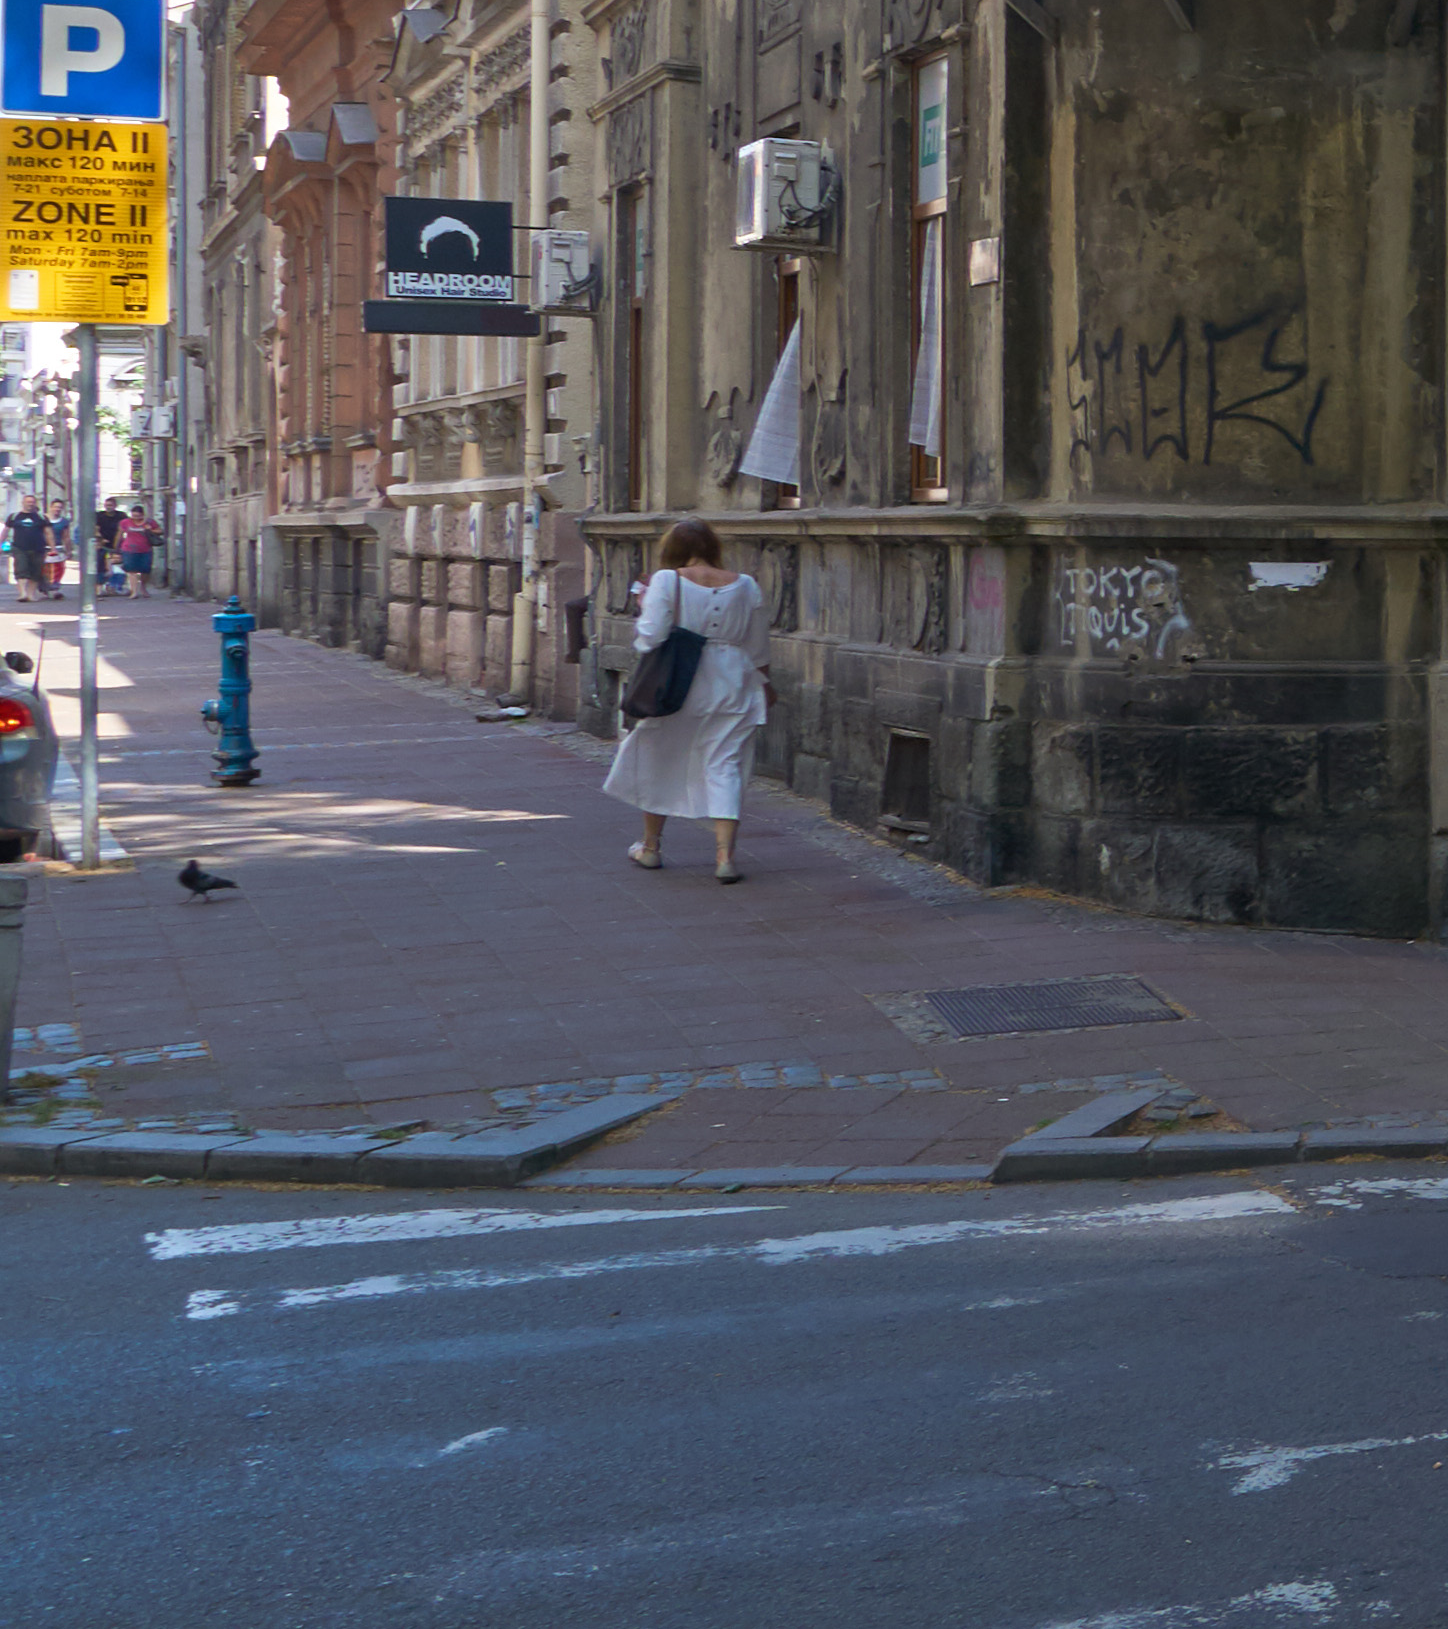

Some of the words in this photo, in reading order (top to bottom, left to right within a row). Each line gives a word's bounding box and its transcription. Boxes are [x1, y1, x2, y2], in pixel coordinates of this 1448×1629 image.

[41, 4, 125, 97] P
[12, 126, 117, 152] ЗОНА
[132, 132, 149, 153] II
[7, 155, 62, 168] макс
[69, 156, 104, 170] 120
[113, 161, 155, 172] мин
[7, 173, 67, 183] наплата
[72, 176, 154, 188] паркирања
[14, 184, 40, 193] 7-21
[50, 186, 111, 196] суботом
[120, 188, 148, 197] 7-14
[12, 201, 116, 226] ZONE
[130, 205, 147, 227] II
[7, 229, 54, 241] max
[65, 229, 102, 243] 120
[112, 231, 152, 244] min
[10, 245, 41, 255] Mon
[57, 246, 74, 256] Fri
[81, 247, 148, 259] 7am-9pm
[9, 256, 75, 269] Saturday
[81, 258, 148, 271] 7am-2pm
[388, 272, 512, 288] HEADROOM
[396, 286, 437, 295] Unisex
[442, 288, 465, 296] Hair
[469, 289, 507, 297] Studio
